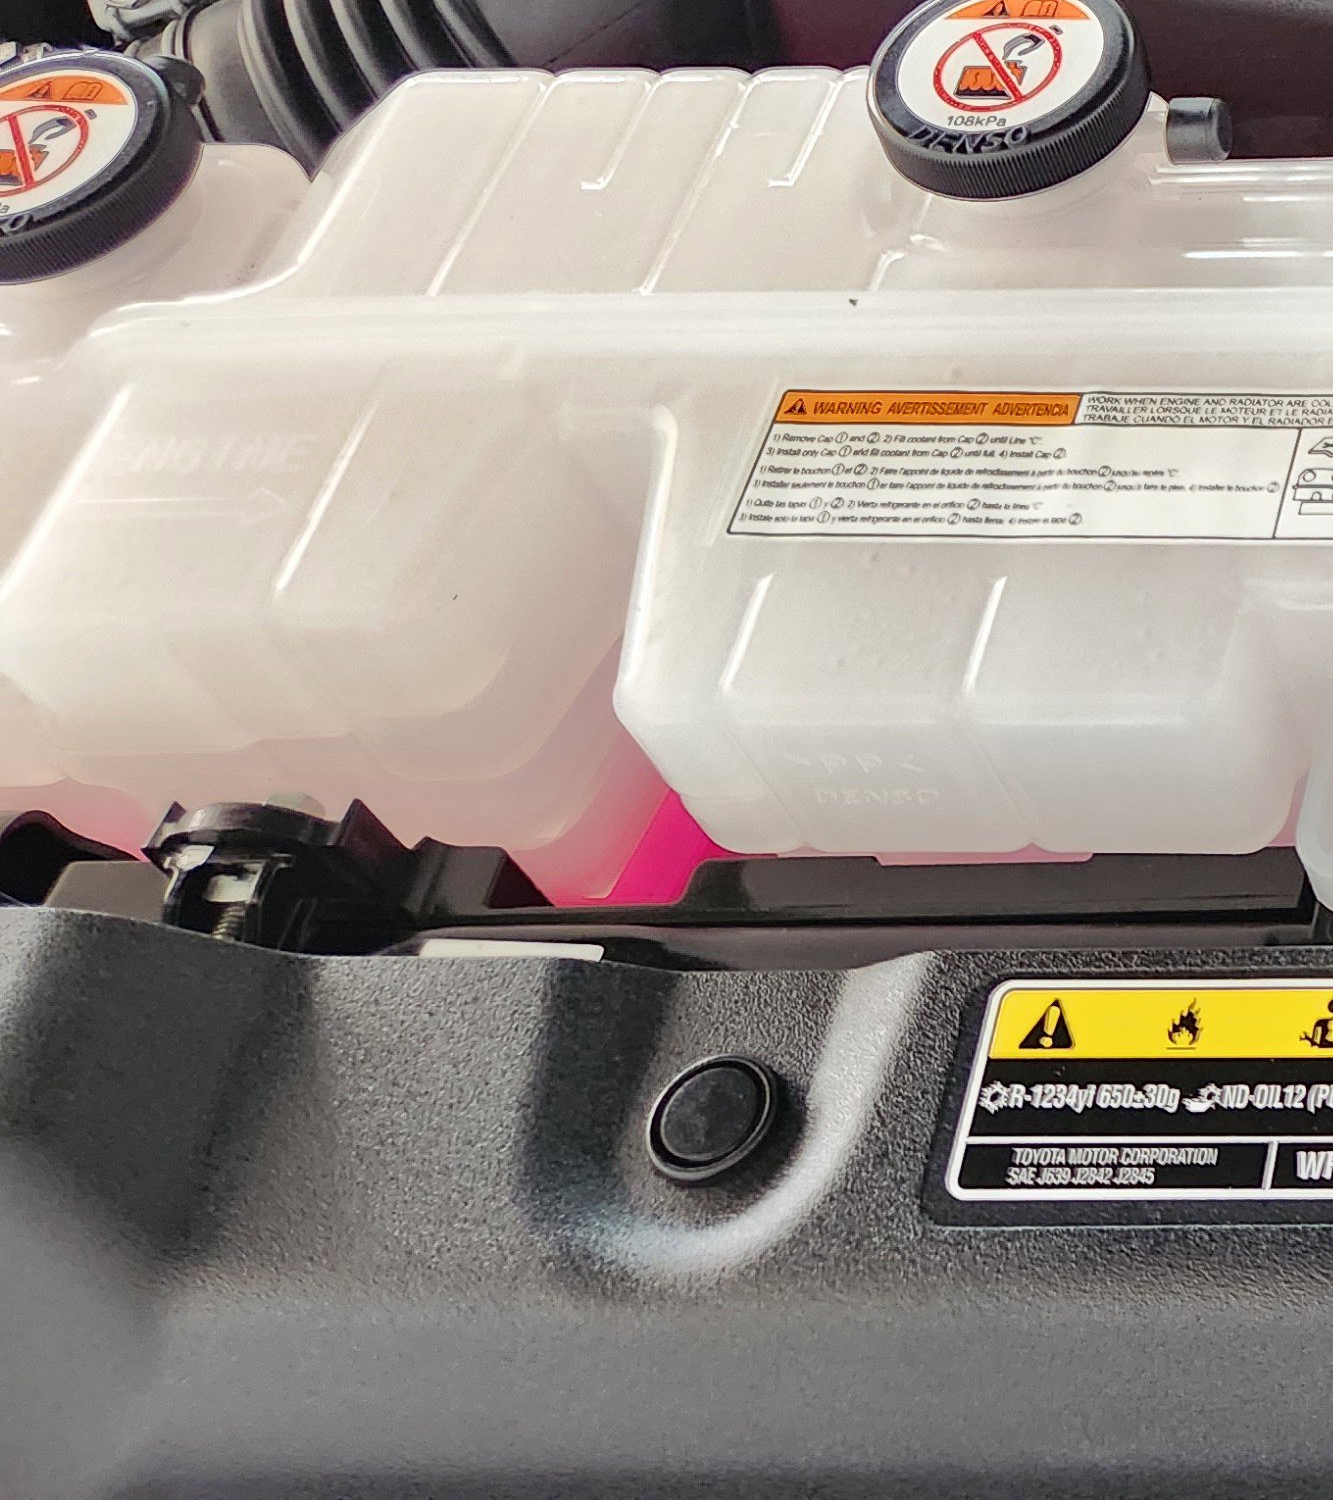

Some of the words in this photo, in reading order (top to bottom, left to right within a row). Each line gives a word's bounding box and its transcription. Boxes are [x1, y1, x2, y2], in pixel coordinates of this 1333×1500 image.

[947, 115, 1007, 127] 108kPa
[907, 125, 1031, 153] DENSO
[1088, 397, 1121, 405] WORK
[1160, 398, 1200, 406] ENGINE
[1203, 398, 1227, 406] AND
[1230, 398, 1284, 407] RADIATOR
[814, 402, 882, 414] WARNING
[888, 402, 988, 416] AVERTISSEMENT
[992, 403, 1069, 416] ADVERTENCIA
[1150, 406, 1201, 414] LORSQUE
[1221, 407, 1266, 415] MOTEUR
[1286, 408, 1297, 416] LE
[1083, 415, 1129, 423] TRABAJE
[1183, 416, 1195, 424] EL
[1199, 416, 1238, 424] MOTOR
[1268, 417, 1324, 425] RADIADOR
[782, 434, 816, 442] Remove
[818, 435, 833, 444] Cap
[958, 435, 974, 444] Cap
[776, 448, 801, 456] Install
[932, 449, 948, 458] Cap
[1009, 1084, 1096, 1114] R-1234yf
[1096, 1083, 1181, 1113] 650±30g
[1012, 1148, 1066, 1165] TOYOTA
[1068, 1148, 1119, 1166] MOTOR
[1120, 1148, 1218, 1166] CORPORATION
[1006, 1167, 1037, 1185] SAE
[1038, 1167, 1071, 1184] J639
[1072, 1167, 1113, 1185] J2842
[1113, 1167, 1156, 1185] J2845
